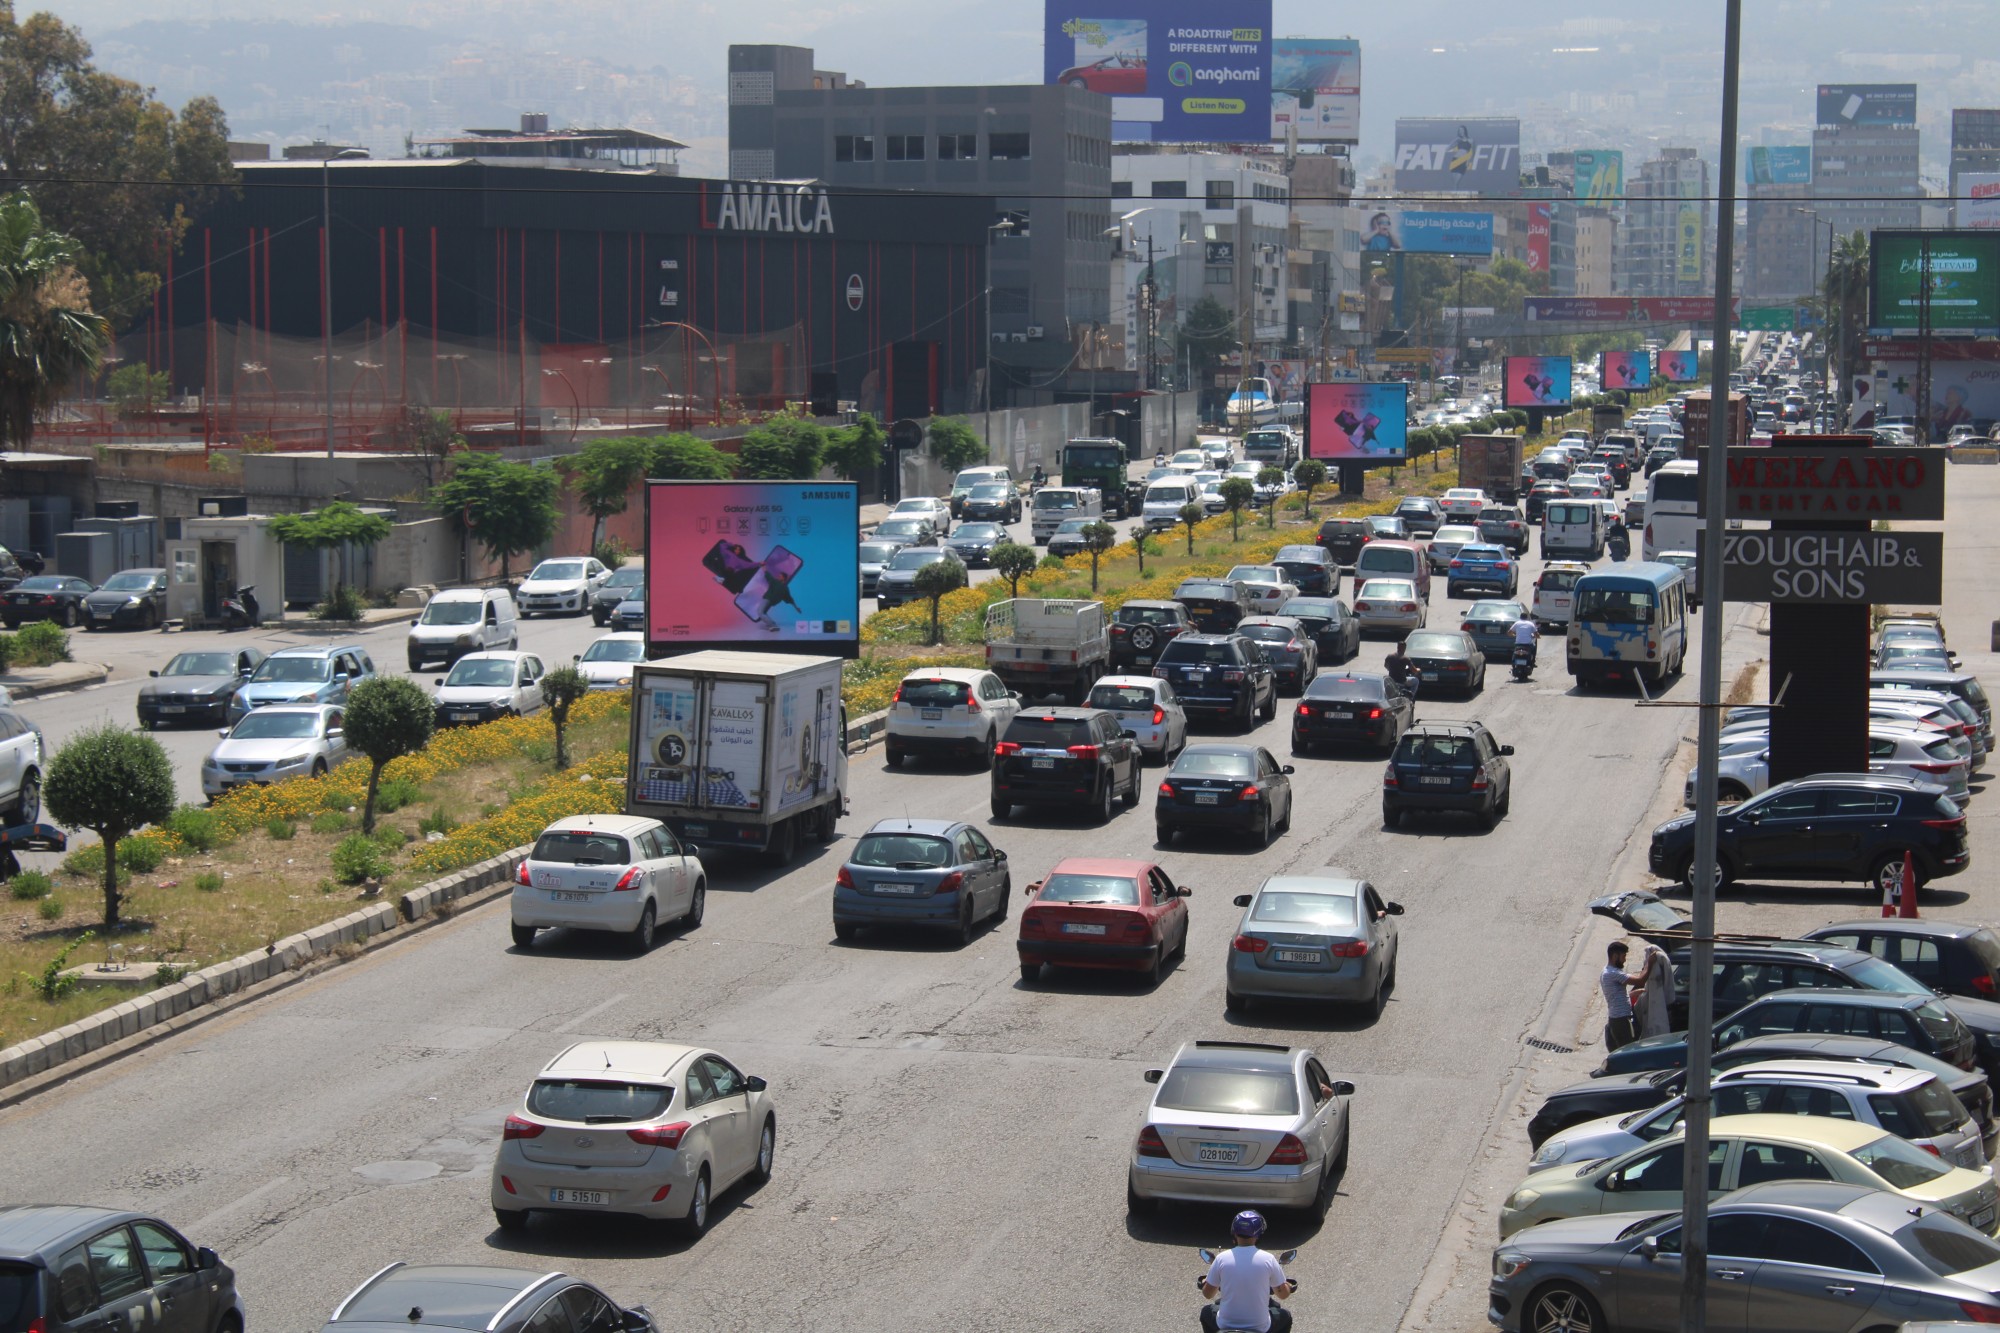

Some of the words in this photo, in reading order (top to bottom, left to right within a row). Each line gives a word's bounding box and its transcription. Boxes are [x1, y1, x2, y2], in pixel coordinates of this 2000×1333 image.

[1168, 28, 1176, 38] A
[1178, 28, 1232, 39] ROADTRIP
[1235, 30, 1259, 40] HITS
[1170, 43, 1228, 53] DIFFERENT
[1230, 44, 1257, 54] WITH
[1195, 66, 1260, 84] anghami
[1219, 102, 1237, 110] Now
[1395, 144, 1451, 170] FAT
[1472, 144, 1520, 170] FIT
[700, 182, 834, 234] LAMAICA
[1726, 456, 1925, 489] MEKANO
[801, 491, 850, 500] SAMSUNG
[1738, 494, 1812, 511] RENT
[1822, 495, 1838, 511] A
[1846, 496, 1902, 511] CAR
[724, 505, 753, 514] Galaxy
[1723, 535, 1900, 567] ZOUGHAIB
[1903, 548, 1923, 567] &
[1771, 569, 1865, 599] SONS
[711, 707, 754, 720] KAVALLOS
[1290, 952, 1316, 962] 196813
[557, 1190, 564, 1201] B
[572, 1191, 601, 1204] 51510
